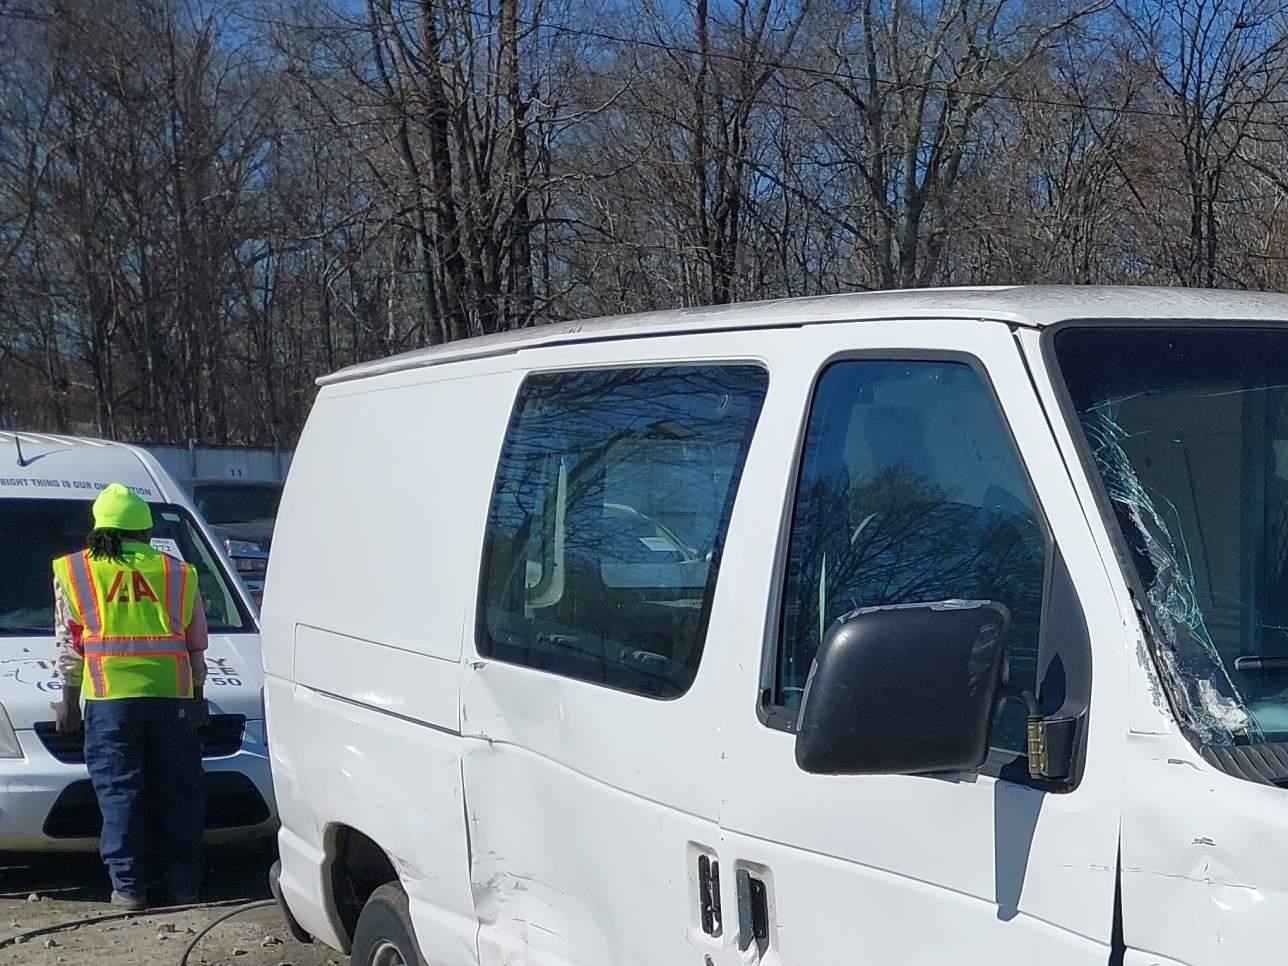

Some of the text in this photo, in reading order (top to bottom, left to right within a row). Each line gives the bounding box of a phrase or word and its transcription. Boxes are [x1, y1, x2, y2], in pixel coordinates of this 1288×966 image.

[30, 478, 60, 488] THING
[61, 480, 71, 488] IS
[73, 480, 92, 489] OUR
[94, 482, 109, 490] ON
[127, 486, 152, 496] TION
